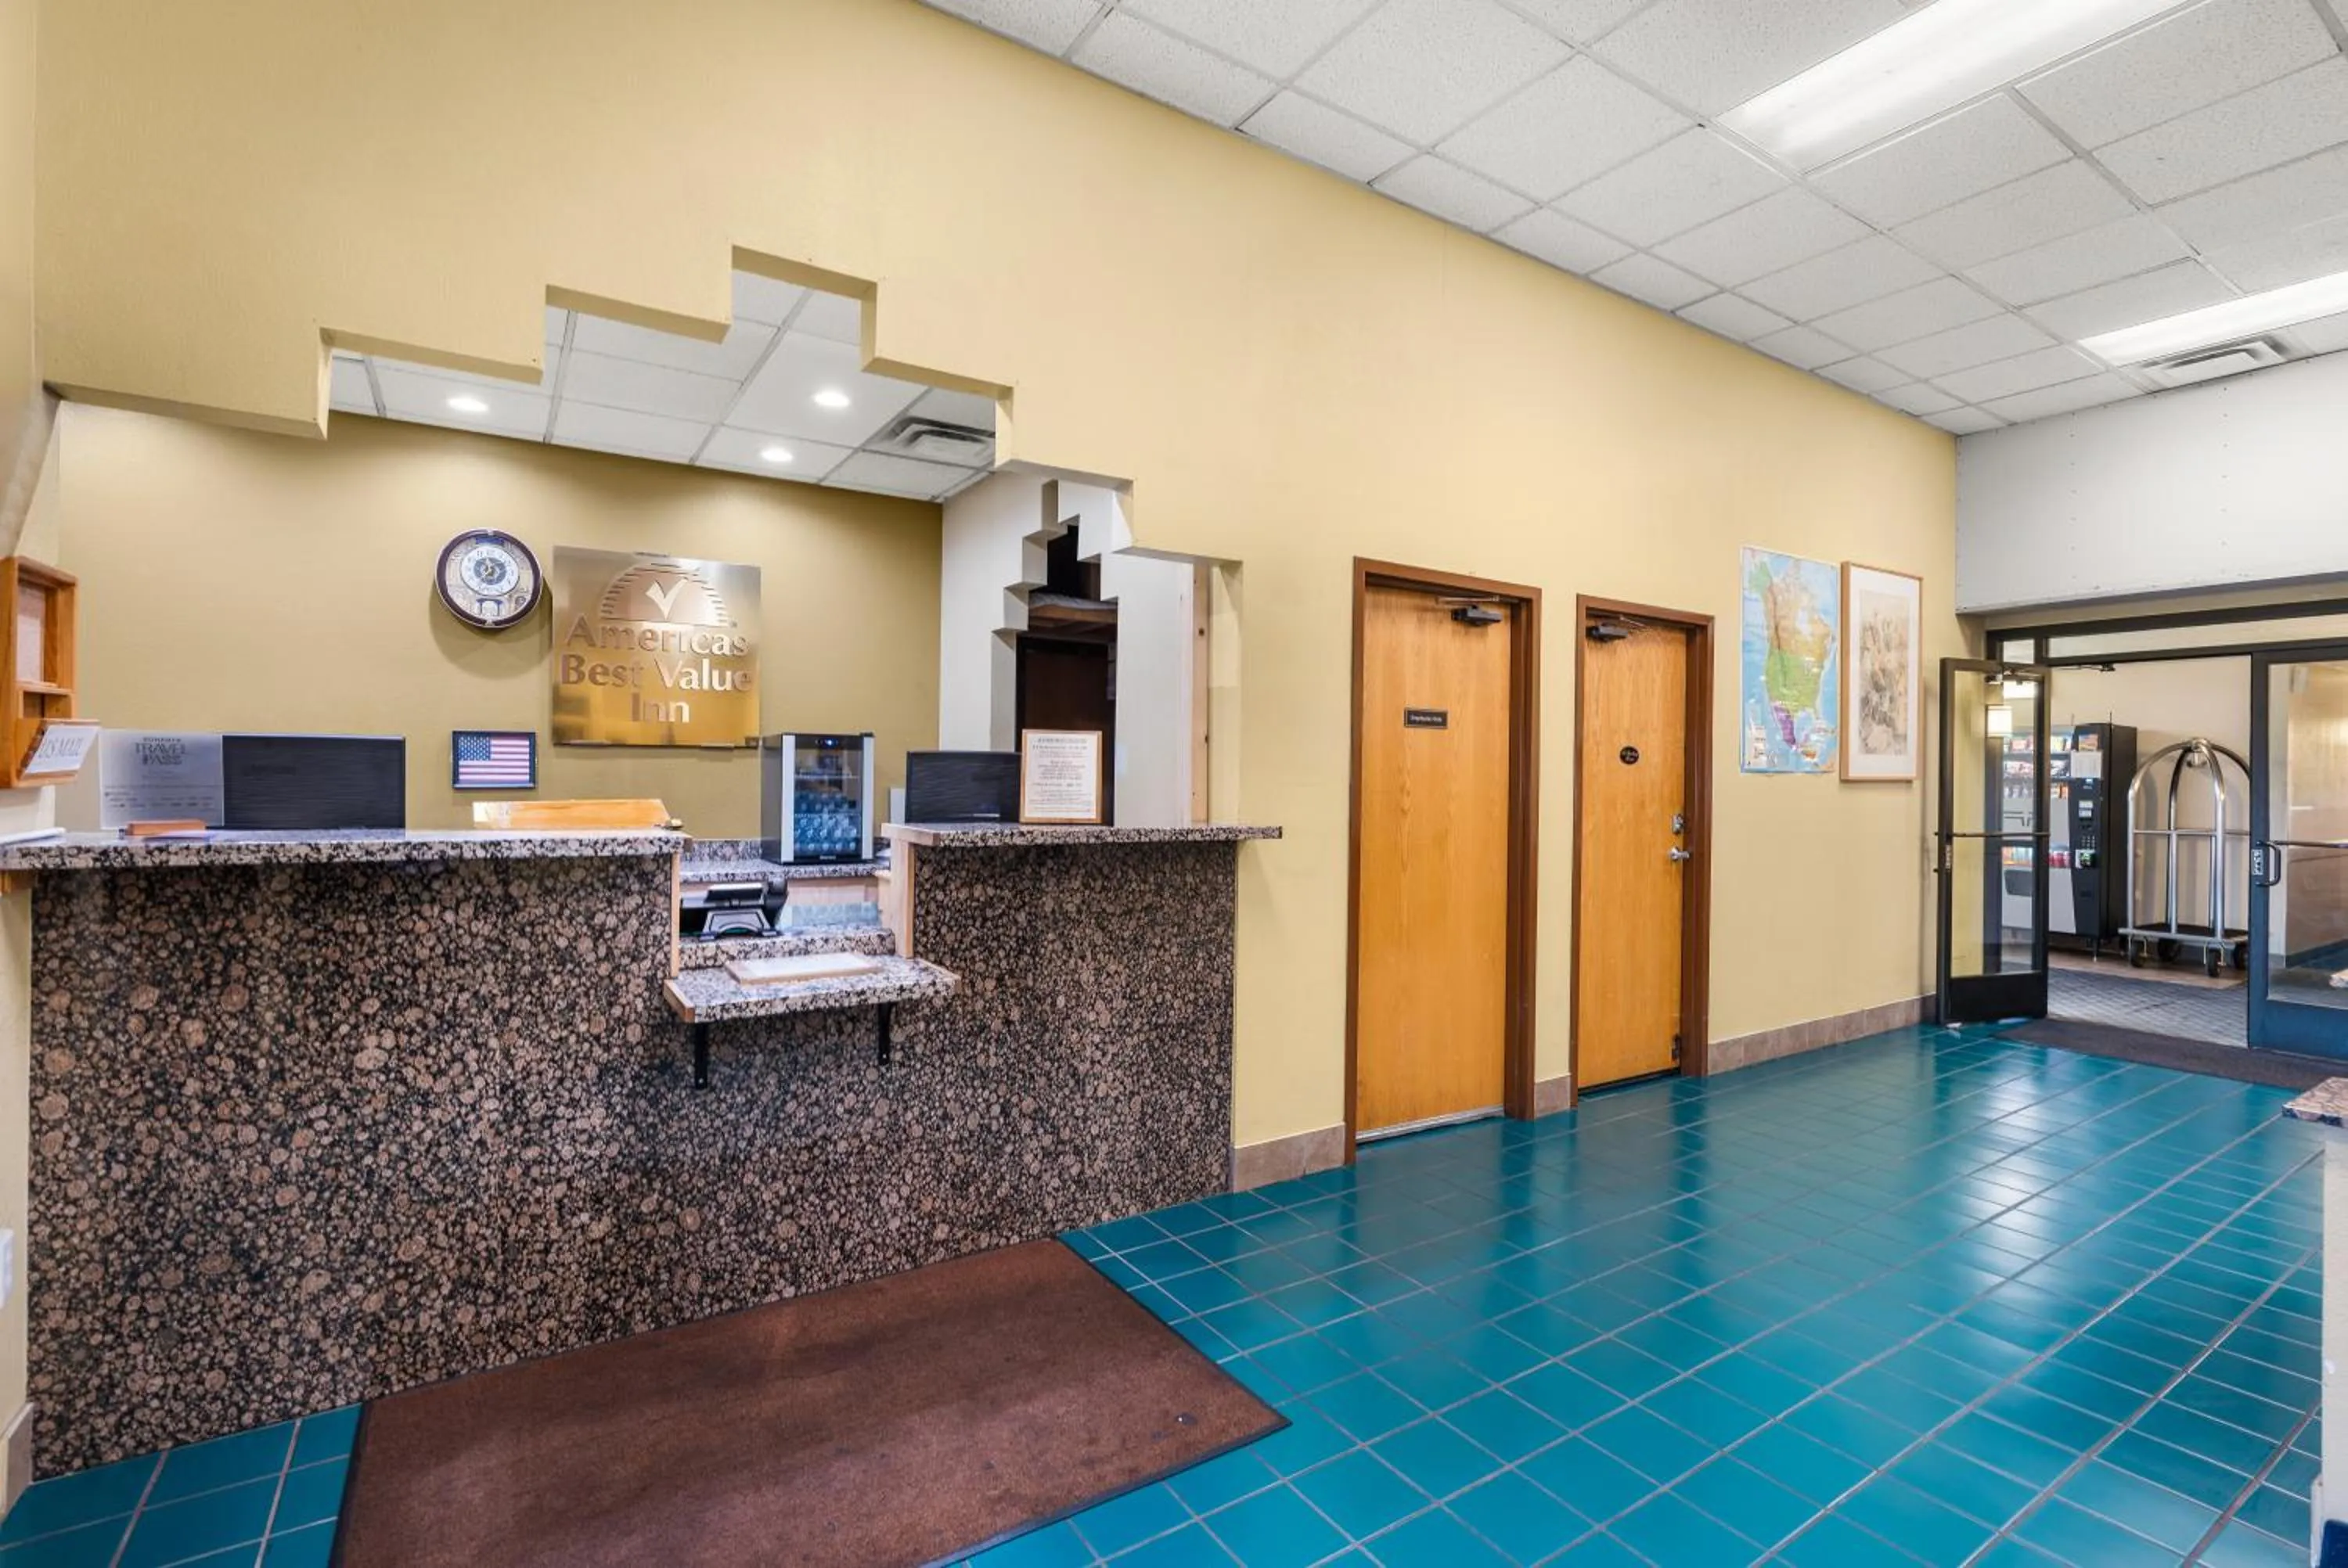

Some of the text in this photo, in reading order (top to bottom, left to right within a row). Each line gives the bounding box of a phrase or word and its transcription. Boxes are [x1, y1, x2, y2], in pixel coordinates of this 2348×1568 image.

[566, 615, 749, 656] Americas
[562, 655, 752, 691] Best Value
[632, 692, 690, 723] Inn
[142, 754, 182, 765] PASS
